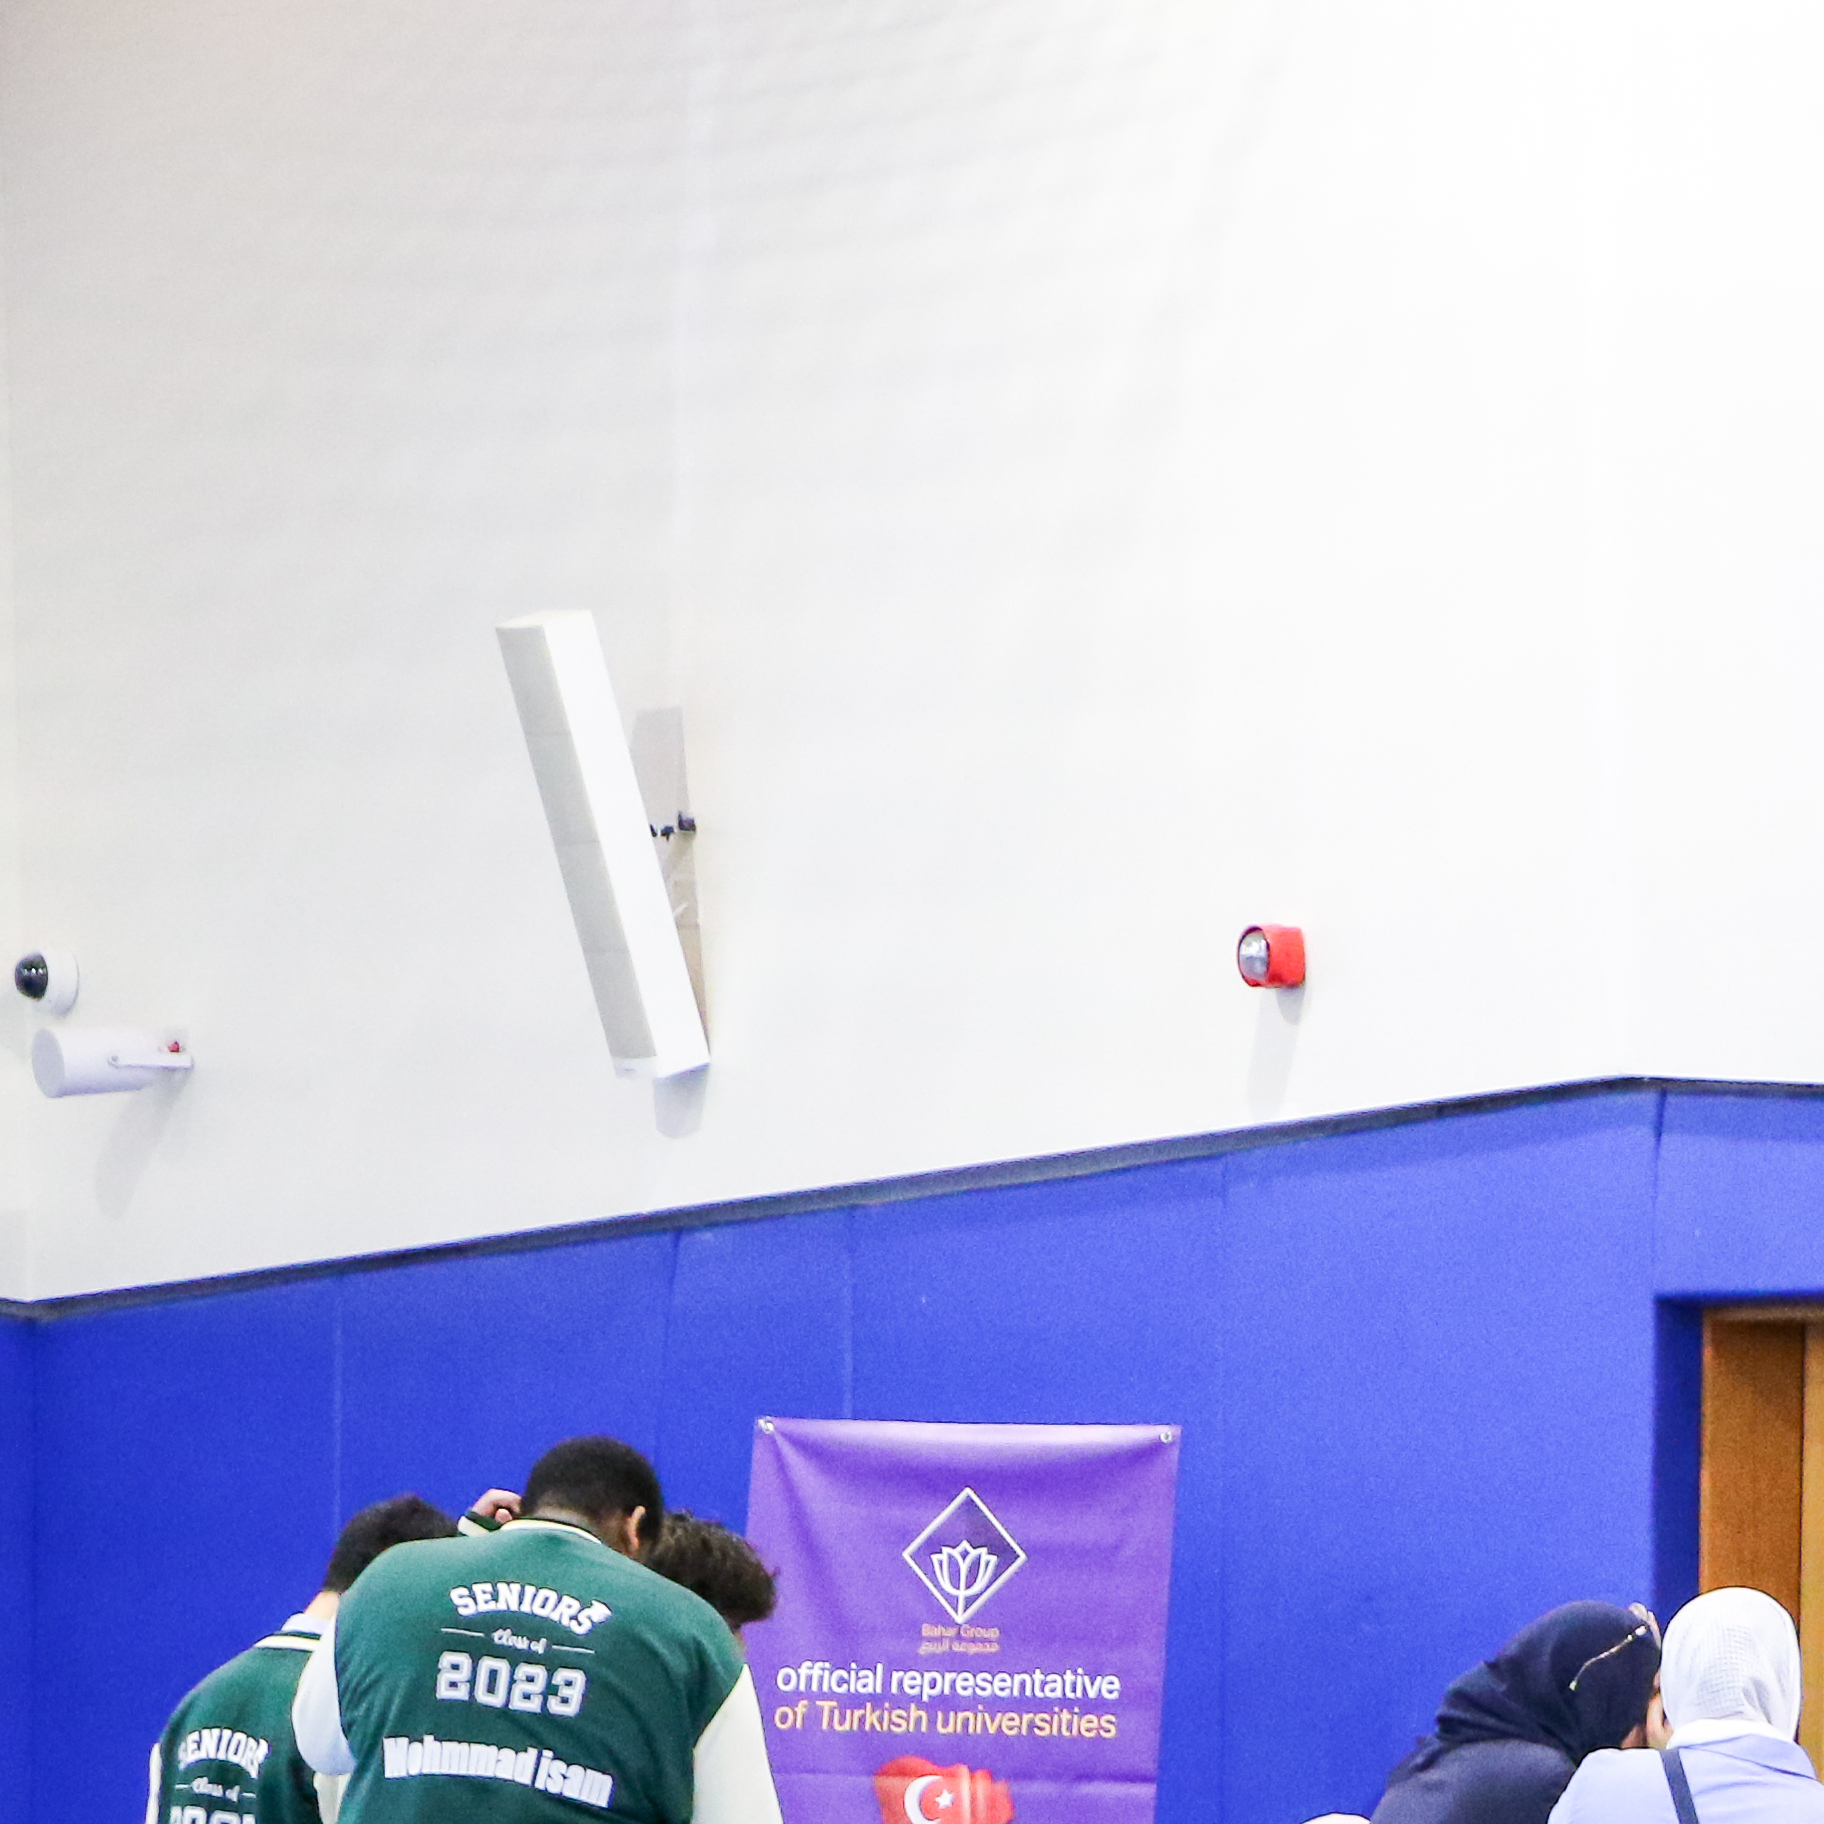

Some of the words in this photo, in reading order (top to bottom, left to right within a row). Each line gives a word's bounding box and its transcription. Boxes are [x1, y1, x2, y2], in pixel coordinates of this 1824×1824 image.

[449, 1581, 604, 1636] SENIORS
[435, 1650, 588, 1717] 2023
[776, 1660, 884, 1694] official
[890, 1667, 1122, 1702] representative
[773, 1700, 808, 1731] of
[815, 1700, 928, 1735] Turkish
[936, 1704, 1117, 1738] universities
[177, 1727, 265, 1780] SENIORS
